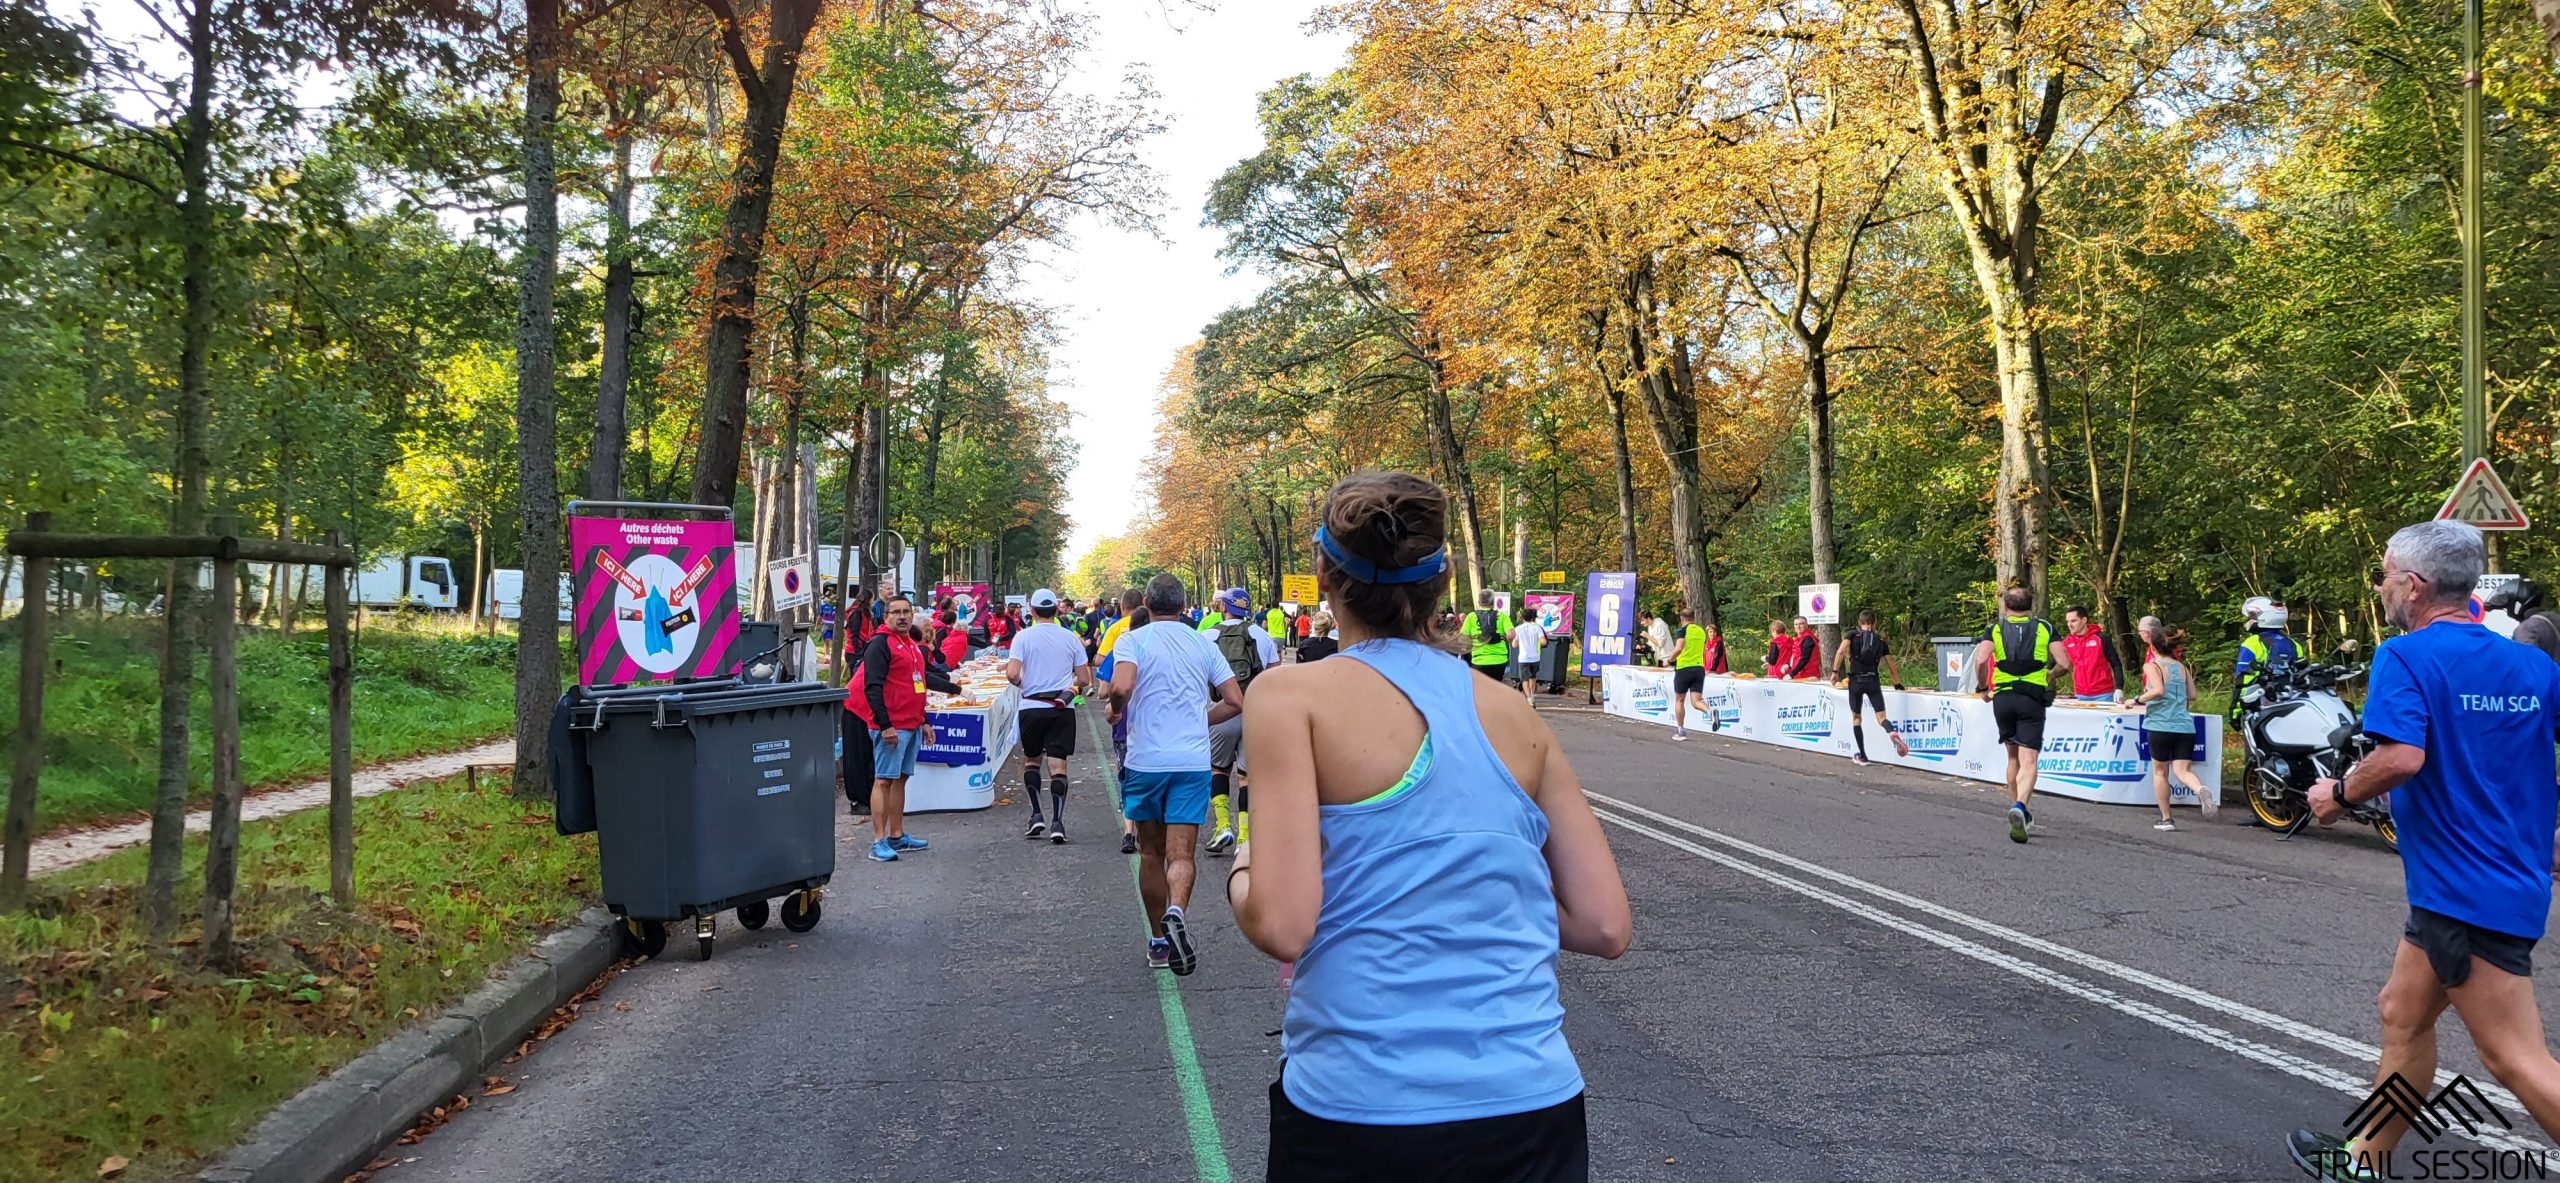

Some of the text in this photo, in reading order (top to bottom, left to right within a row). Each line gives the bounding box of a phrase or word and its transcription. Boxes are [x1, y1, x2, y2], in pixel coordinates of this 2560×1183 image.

[620, 522, 684, 534] Autres déchets
[626, 534, 678, 545] Other waste
[770, 560, 787, 571] COURSE
[603, 558, 615, 572] ICI
[620, 573, 642, 595] HERE
[673, 590, 684, 602] ICI
[687, 563, 707, 585] HERE
[1598, 593, 1620, 636] 6
[1589, 635, 1625, 656] KM
[2459, 694, 2541, 712] TEAM SCA
[1777, 705, 1817, 719] OBJECTIF
[947, 728, 967, 738] KM
[1781, 721, 1804, 732] COURSE
[1804, 720, 1830, 731] PROPRE
[1891, 719, 1938, 733] BJECTIF
[1924, 737, 1957, 748] PROPRE
[2043, 737, 2099, 753] JECTIF
[2037, 758, 2073, 772] OURSE
[2074, 759, 2138, 773] PROPRE
